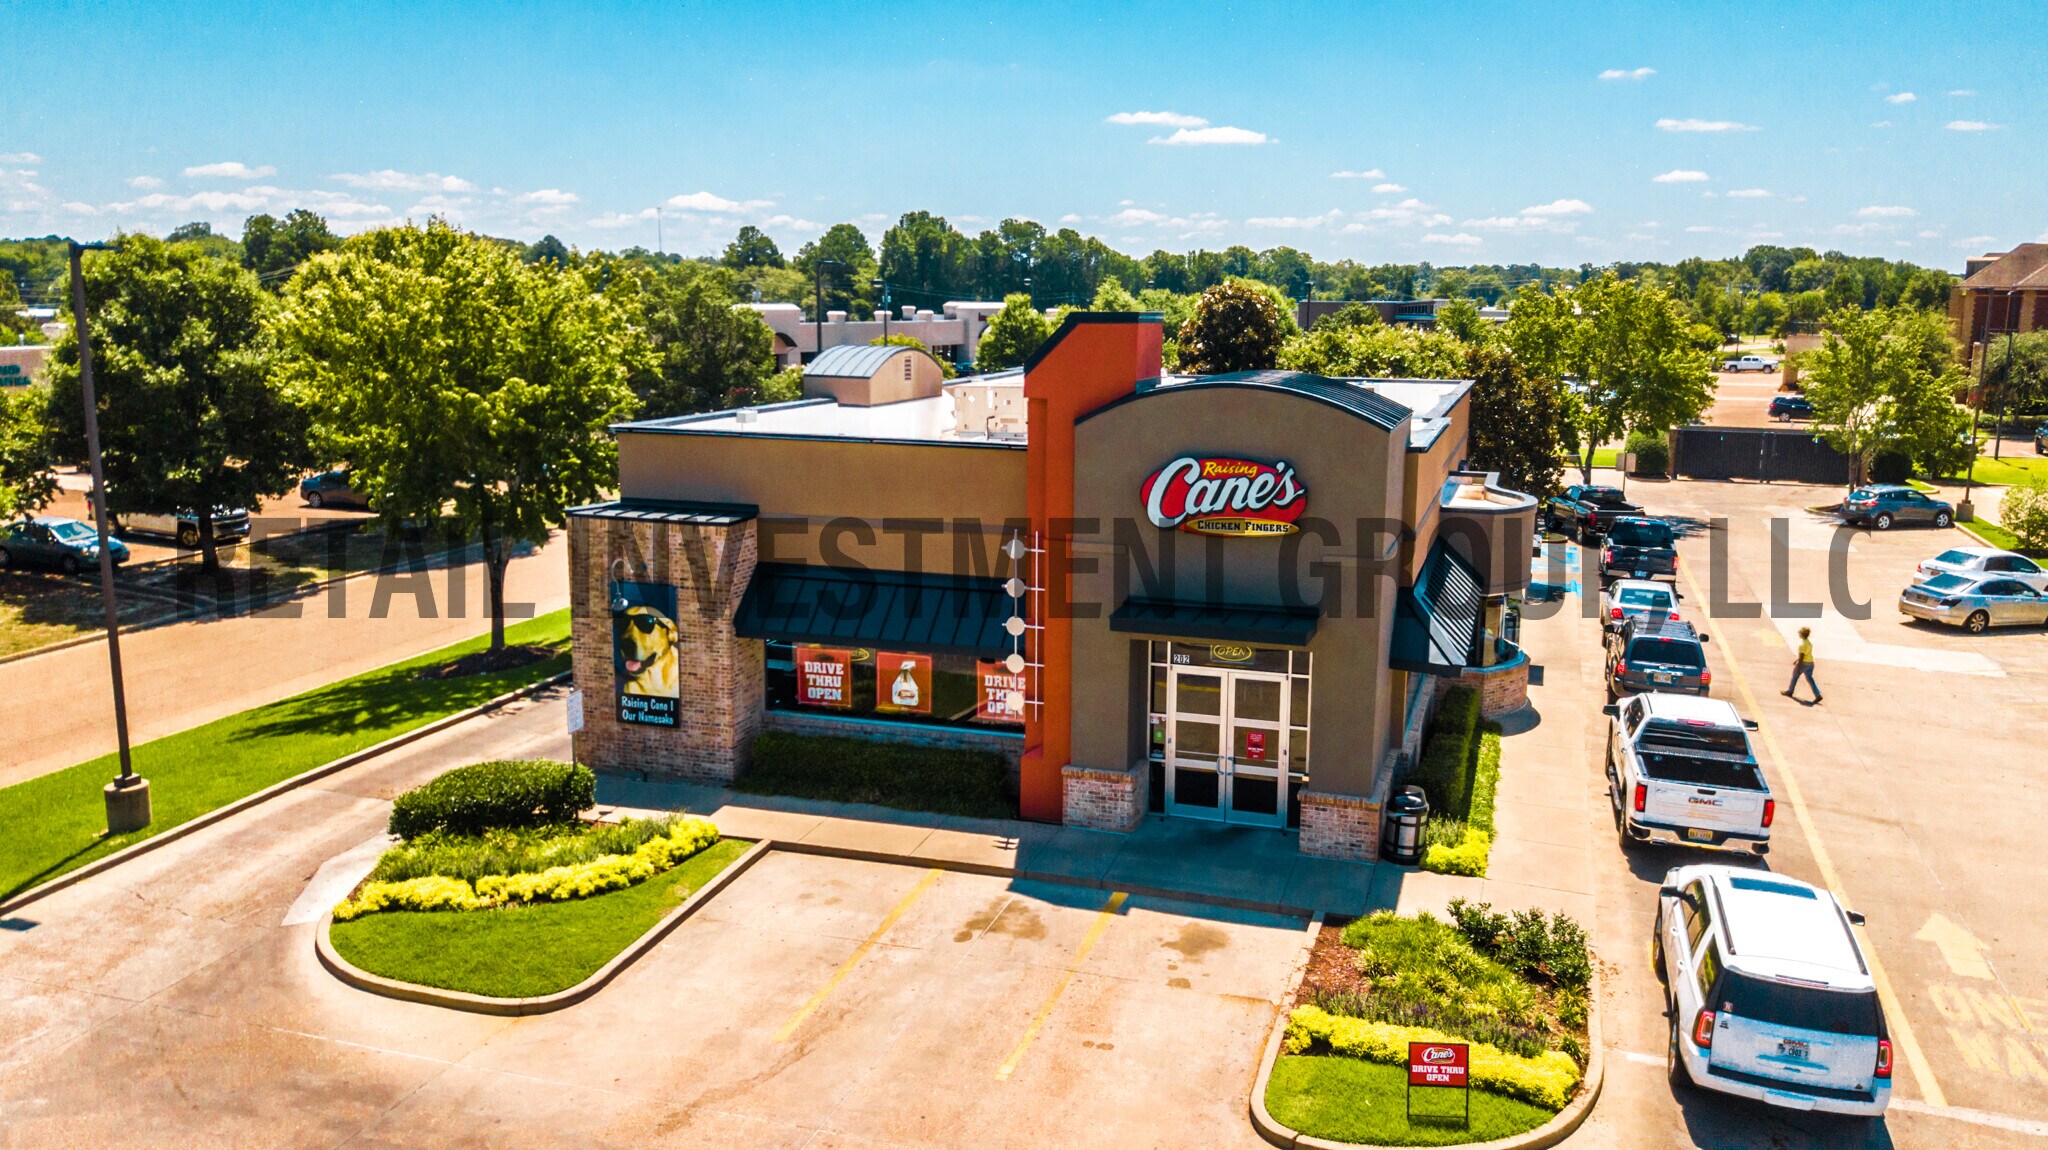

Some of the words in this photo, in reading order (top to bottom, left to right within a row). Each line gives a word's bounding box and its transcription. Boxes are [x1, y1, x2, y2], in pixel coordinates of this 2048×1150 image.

[1202, 461, 1258, 477] Raising
[1147, 457, 1305, 528] Cane's
[1197, 520, 1241, 531] CHICKEN
[1245, 522, 1289, 533] FINGERS
[1217, 646, 1246, 656] OPEN
[1174, 654, 1190, 664] 202
[804, 661, 844, 675] DRIVE
[806, 674, 842, 688] THRU
[984, 674, 1026, 690] DRIVE
[808, 687, 842, 700] OPEN
[986, 688, 1024, 702] TH
[621, 696, 648, 711] Raising
[650, 698, 668, 711] Cane
[622, 709, 636, 720] Our
[638, 711, 674, 725] Namesake
[1688, 797, 1723, 806] GMC
[1423, 1047, 1454, 1062] Cane's
[1412, 1065, 1438, 1073] DRIVE
[1440, 1066, 1464, 1074] THRU
[1426, 1073, 1449, 1082] OPEN
